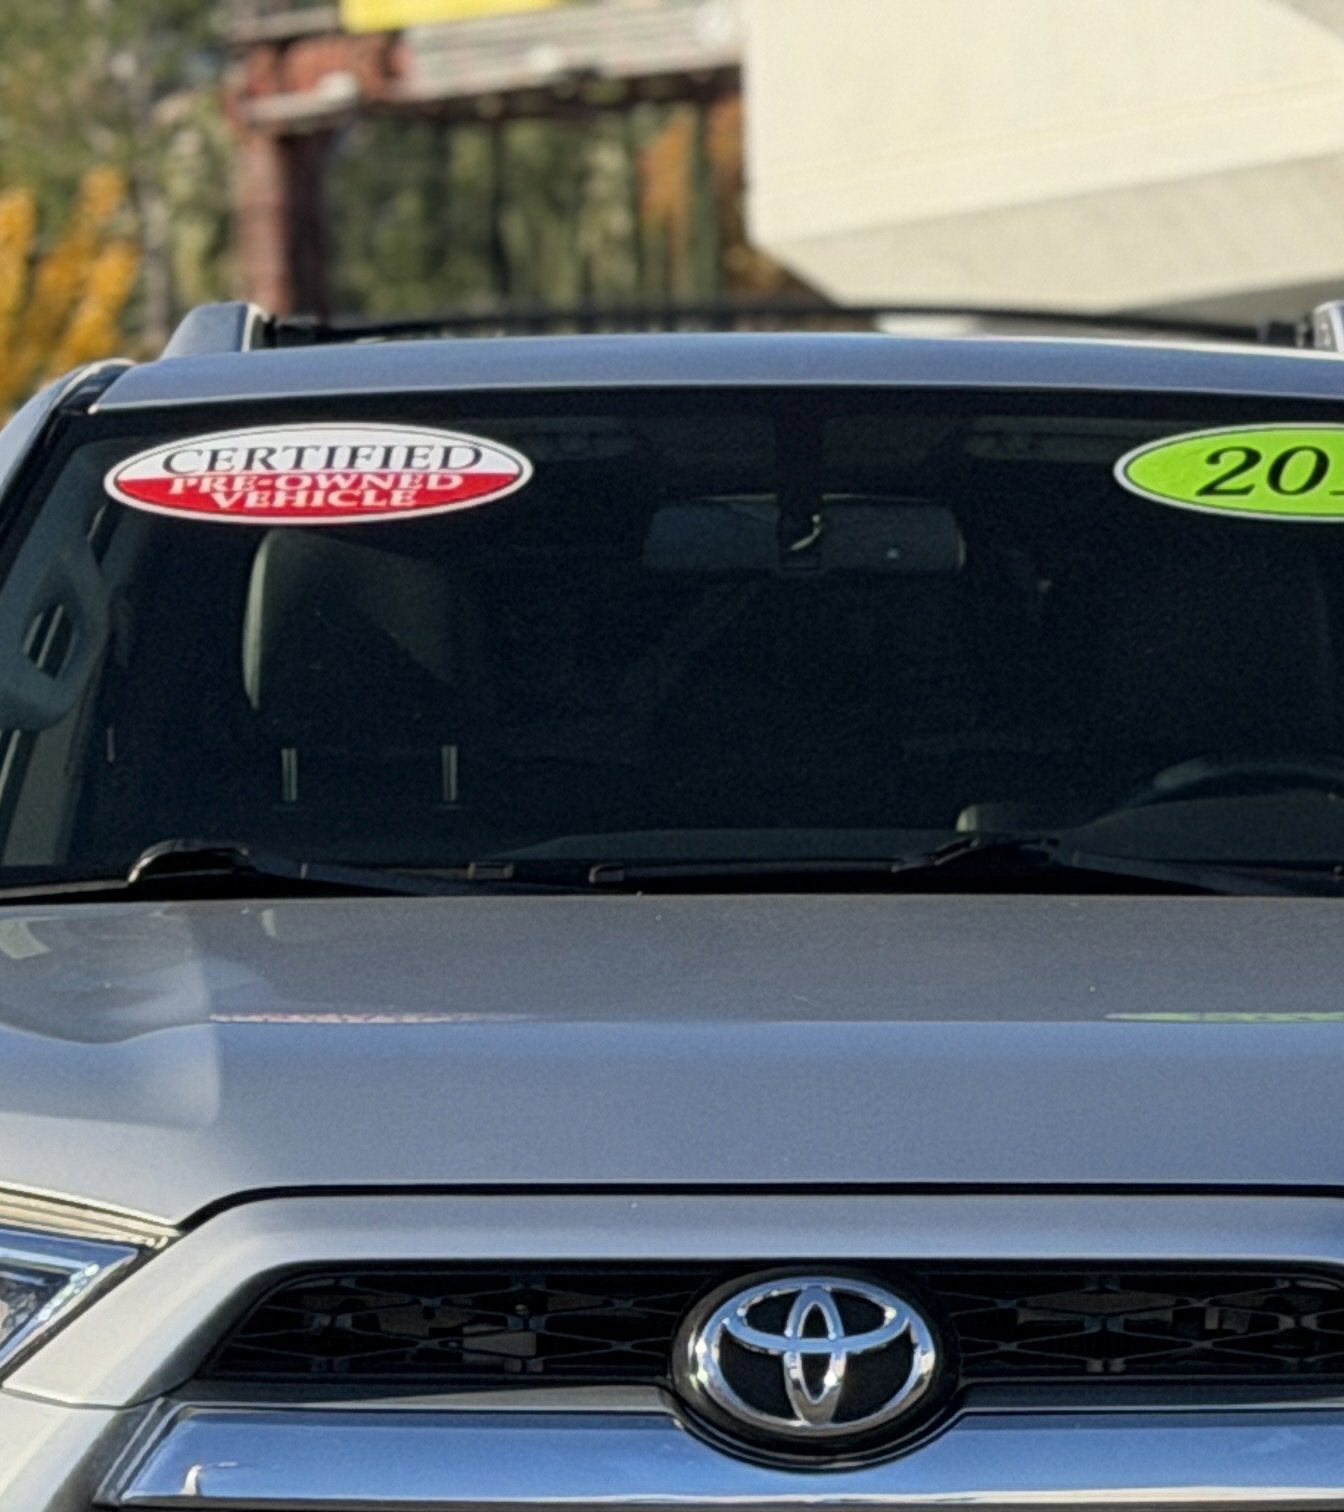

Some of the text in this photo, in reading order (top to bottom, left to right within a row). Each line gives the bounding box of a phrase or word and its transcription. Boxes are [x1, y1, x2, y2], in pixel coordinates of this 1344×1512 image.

[162, 444, 484, 476] CERTIFIED
[168, 474, 464, 495] PRE-OWNED
[210, 490, 418, 510] VEHICLE
